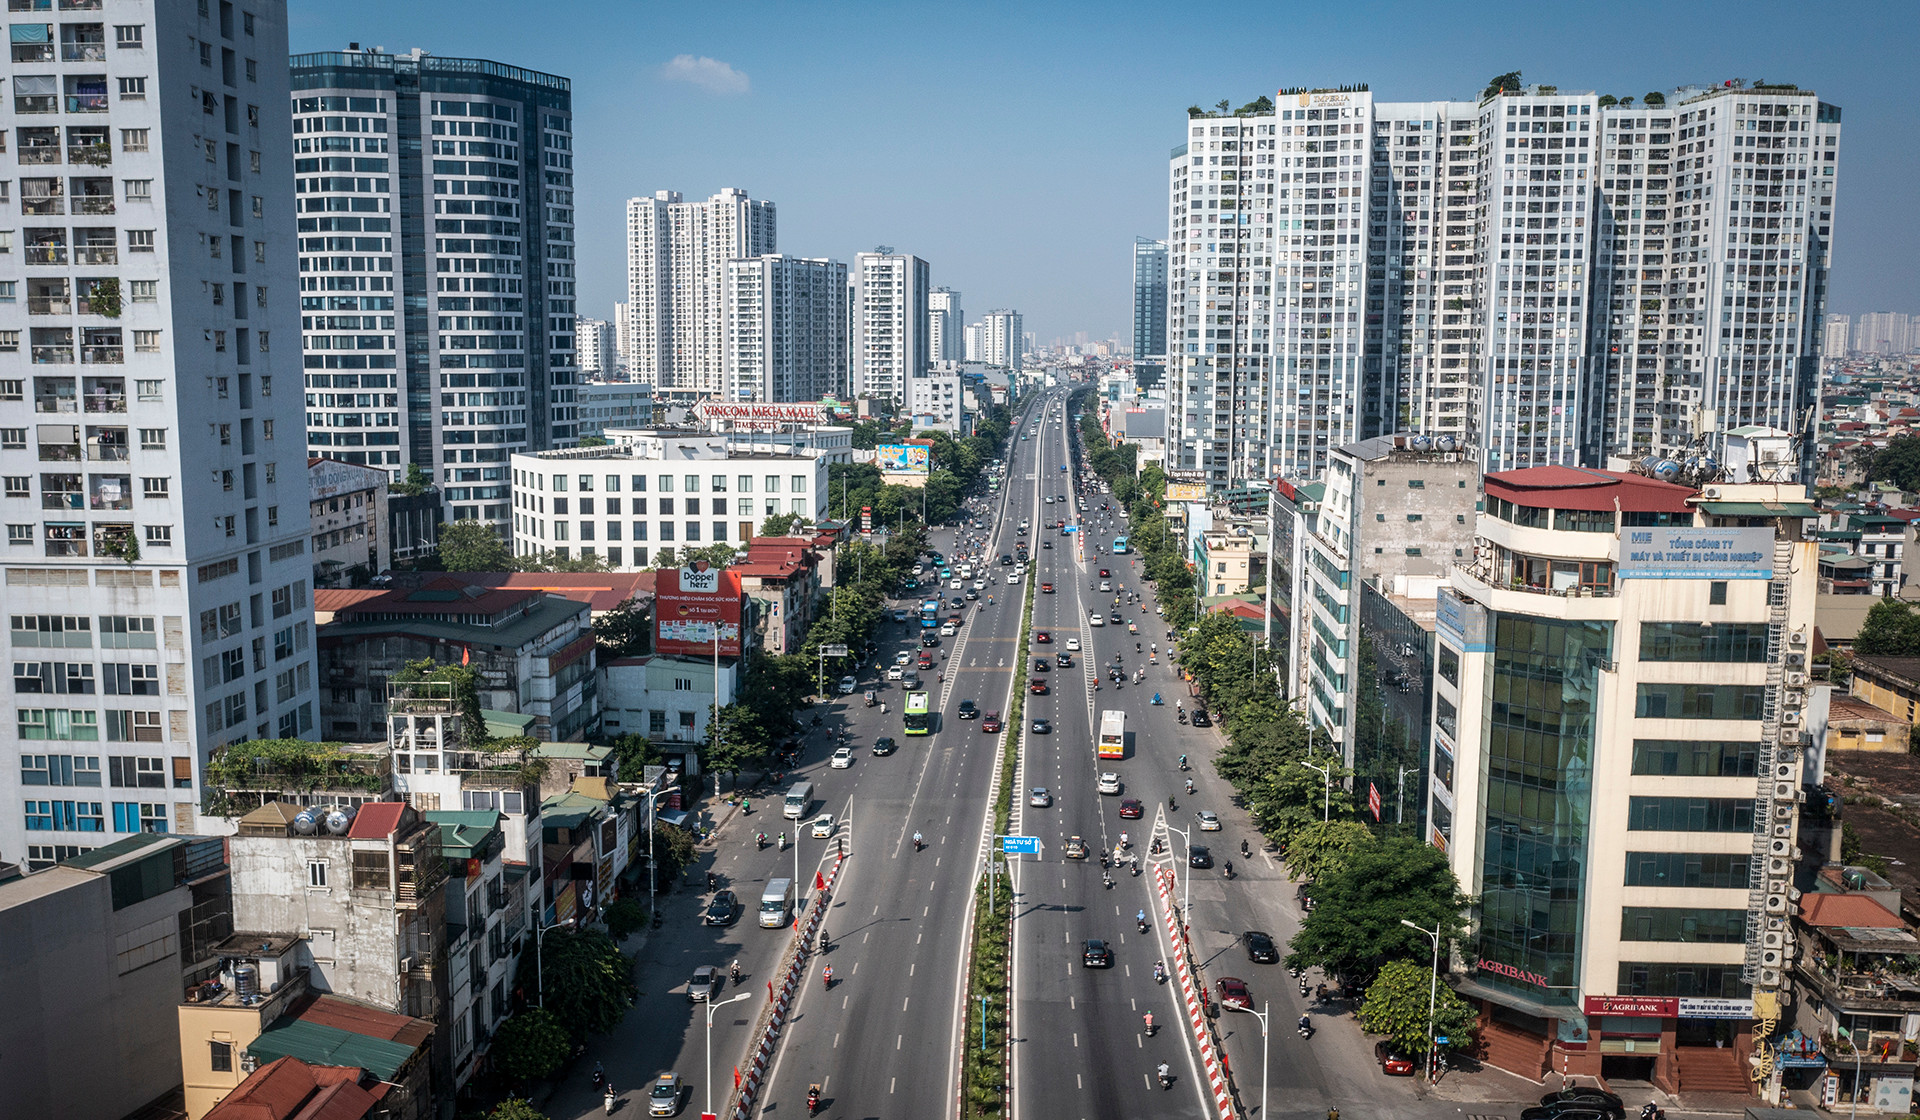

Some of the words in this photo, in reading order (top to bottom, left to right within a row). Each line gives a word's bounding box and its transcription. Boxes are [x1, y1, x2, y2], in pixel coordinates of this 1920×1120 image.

[703, 405, 749, 417] VINCOM
[751, 405, 783, 417] MEGA
[785, 406, 817, 418] MALL
[734, 421, 757, 429] TIMES
[759, 421, 777, 429] CITY
[1631, 531, 1653, 542] MIE
[1669, 536, 1694, 549] TỔNG
[1695, 538, 1720, 549] CÔNG
[1722, 540, 1734, 549] TY
[1630, 551, 1651, 562] MÁY
[1652, 551, 1664, 562] VÀ
[1666, 550, 1691, 562] THIẾT
[1692, 552, 1702, 563] BỊ
[1703, 551, 1728, 562] CÔNG
[683, 572, 714, 582] Doppel
[1477, 957, 1548, 988] AGRIBANK
